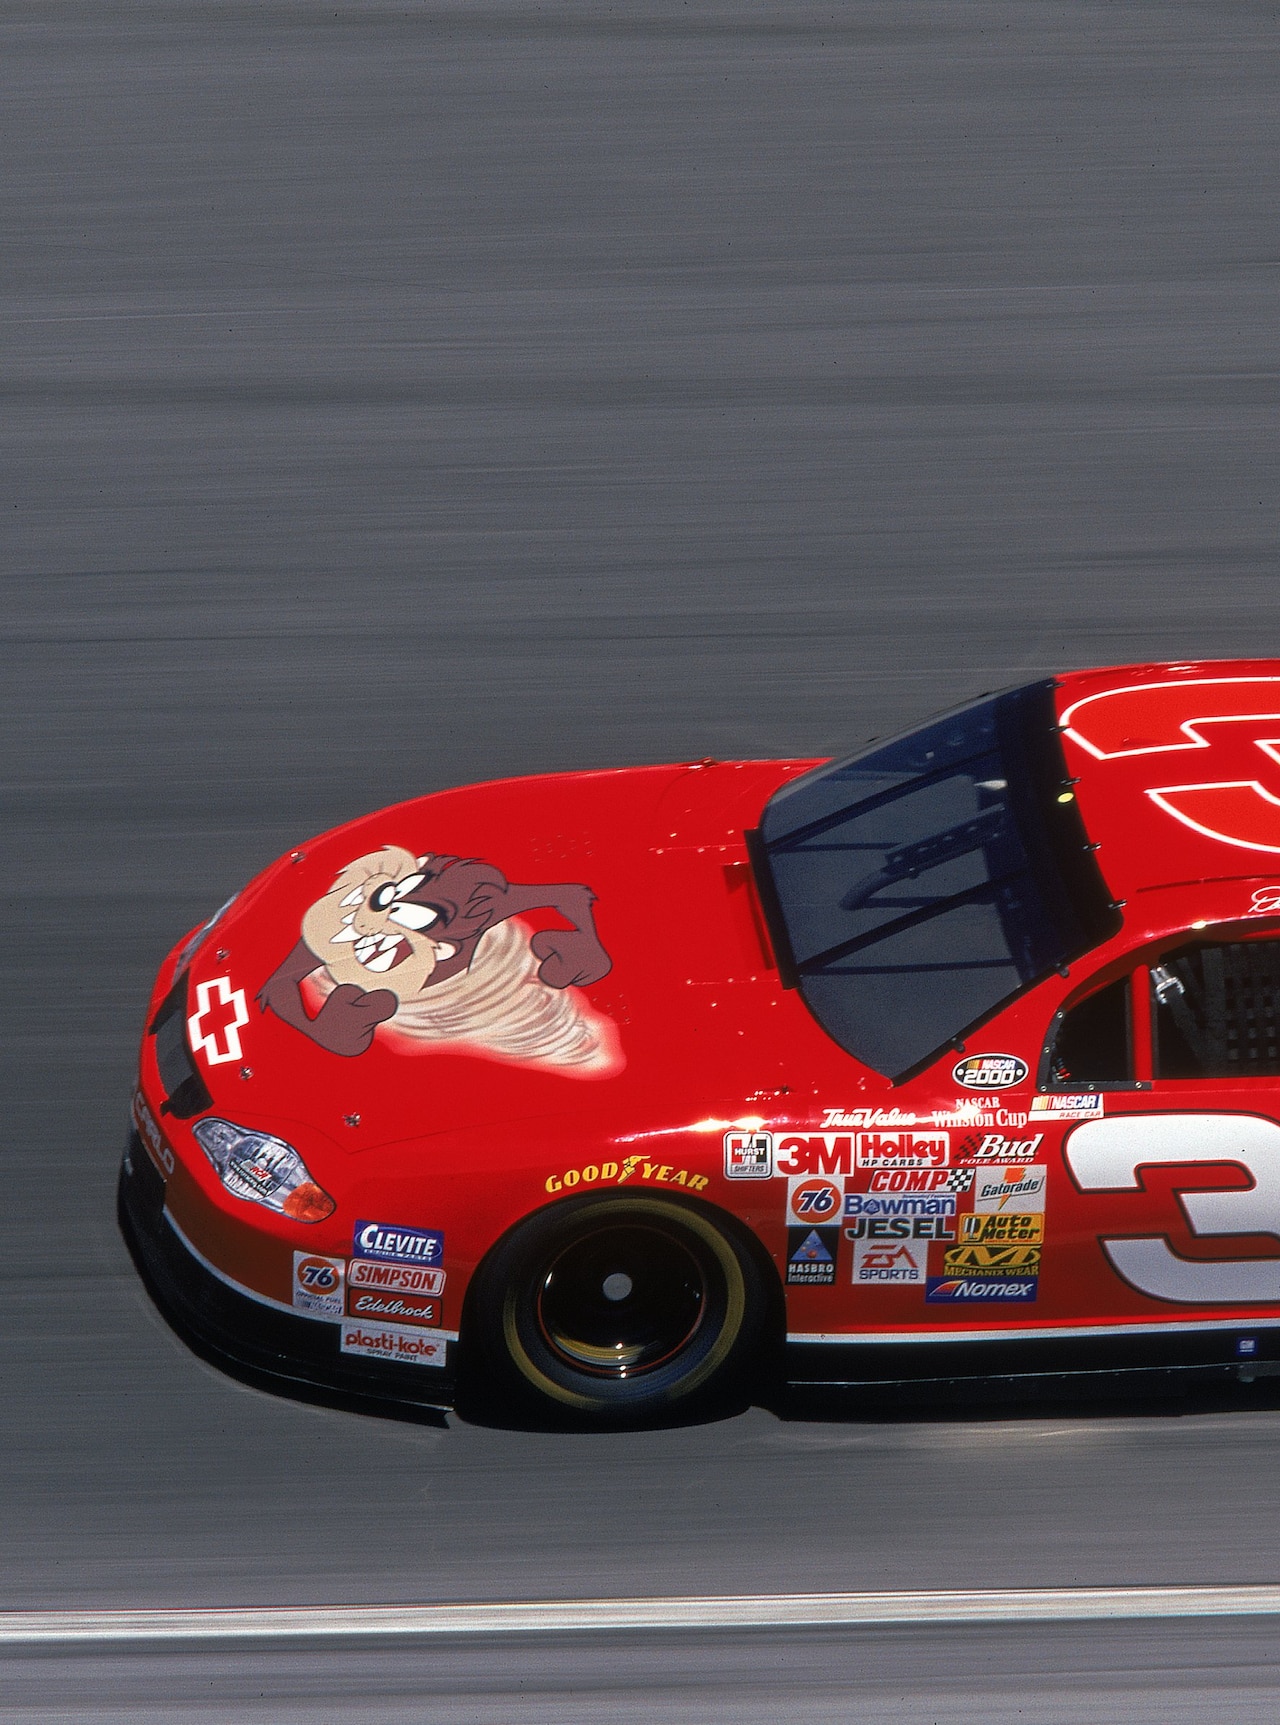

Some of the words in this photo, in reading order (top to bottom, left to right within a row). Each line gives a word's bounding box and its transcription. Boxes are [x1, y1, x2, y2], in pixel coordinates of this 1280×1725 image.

[982, 1059, 1016, 1070] NASCAR
[963, 1069, 1016, 1085] 2000
[955, 1096, 1001, 1109] NASCAR
[1051, 1095, 1099, 1110] NASCAR
[996, 1108, 1028, 1128] Cup
[734, 1148, 766, 1156] HURST
[860, 1134, 946, 1166] Holley
[973, 1133, 1045, 1158] Bud
[777, 1136, 852, 1175] 3M
[883, 1158, 924, 1166] CARBS
[871, 1170, 950, 1192] COMP
[980, 1179, 1040, 1198] Gatorade
[798, 1188, 834, 1212] 76
[843, 1194, 957, 1216] Bowman
[846, 1217, 955, 1240] JESEL
[985, 1214, 1033, 1228] Auto
[359, 1223, 437, 1256] CLEVITE
[982, 1227, 1040, 1240] Meter
[302, 1265, 335, 1287] 76
[788, 1263, 835, 1273] HASBRO
[859, 1269, 919, 1280] SPORTS
[944, 1265, 1004, 1277] MECHANIX
[1005, 1264, 1039, 1276] WEAR
[355, 1265, 438, 1291] SIMPSON
[954, 1282, 1035, 1297] Nomex
[355, 1295, 434, 1319] Edelbrock
[346, 1330, 438, 1356] plasti-kote
